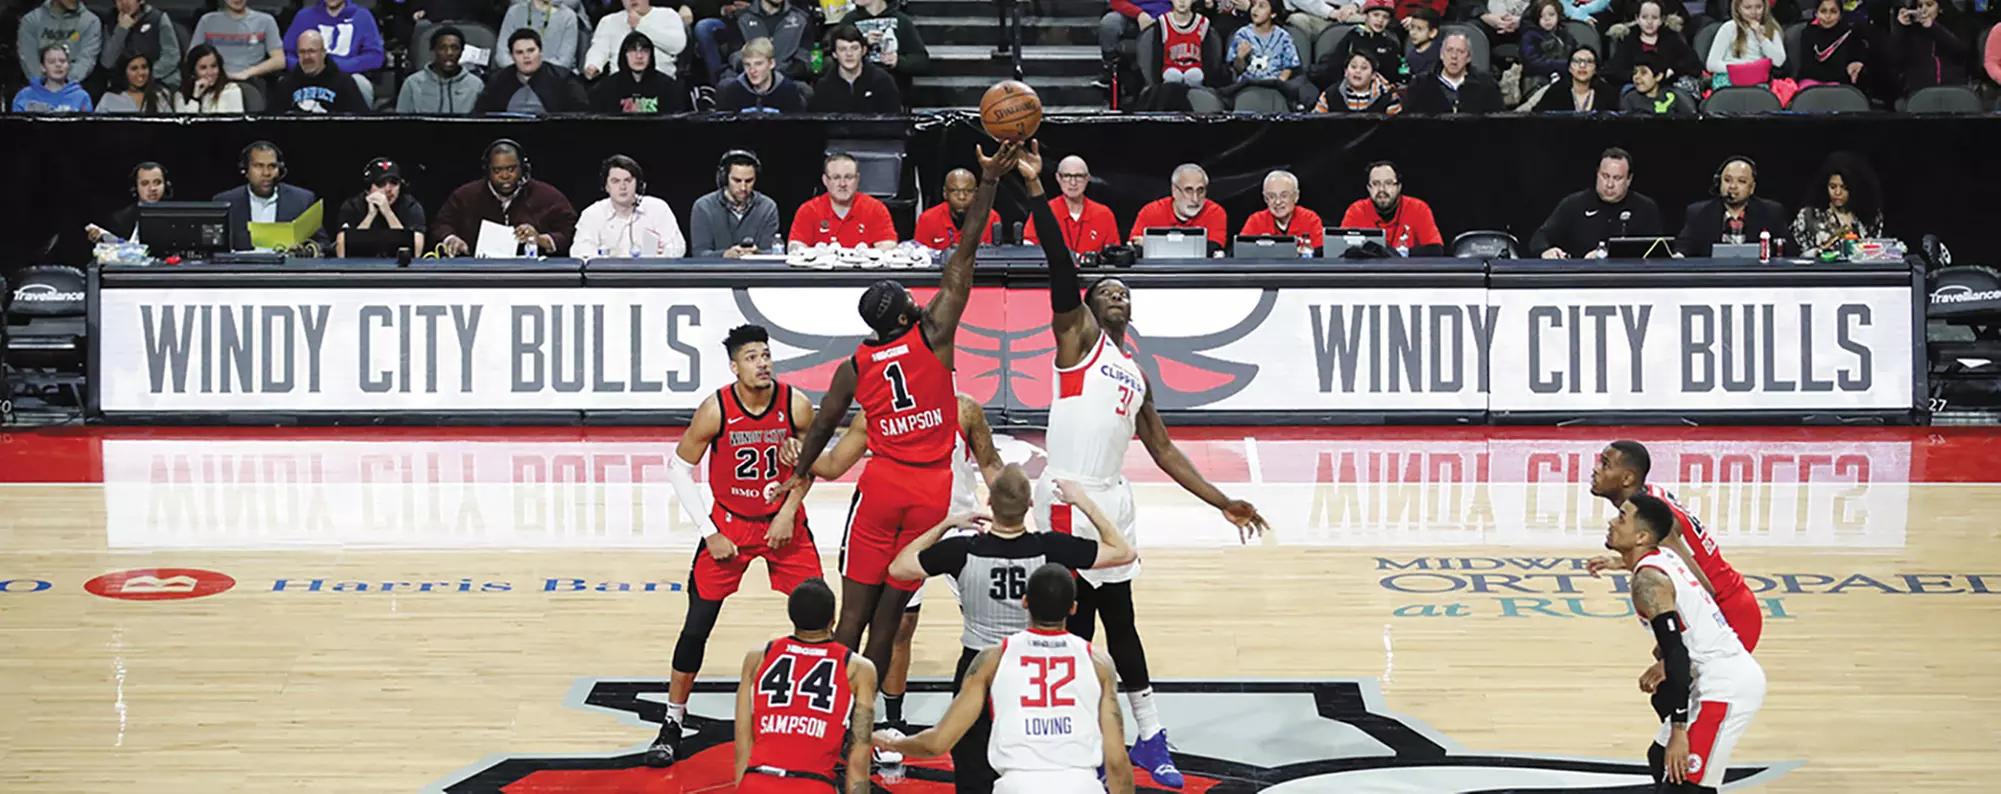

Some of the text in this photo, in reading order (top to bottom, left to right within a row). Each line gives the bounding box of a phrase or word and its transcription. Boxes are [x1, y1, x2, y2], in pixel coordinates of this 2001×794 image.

[139, 304, 702, 394] WINDY CITY BULLS
[1308, 303, 1873, 394] WINDY CITY BULLS
[882, 360, 917, 413] 1
[0, 399, 12, 413] 0
[1928, 397, 1948, 412] 27
[879, 407, 944, 437] SAMPSON
[729, 430, 762, 447] WINDY
[734, 445, 780, 480] 21
[731, 487, 760, 498] BMO
[1372, 557, 1590, 570] MIDWE
[271, 578, 683, 592] Harris Ban
[989, 566, 1027, 600] 36
[1380, 573, 2001, 594] ORTPAE
[1393, 601, 1471, 618] at
[758, 654, 838, 714] 44
[1020, 656, 1076, 708] 32
[760, 714, 828, 739] SAMPSON
[1025, 716, 1072, 736] LOVING
